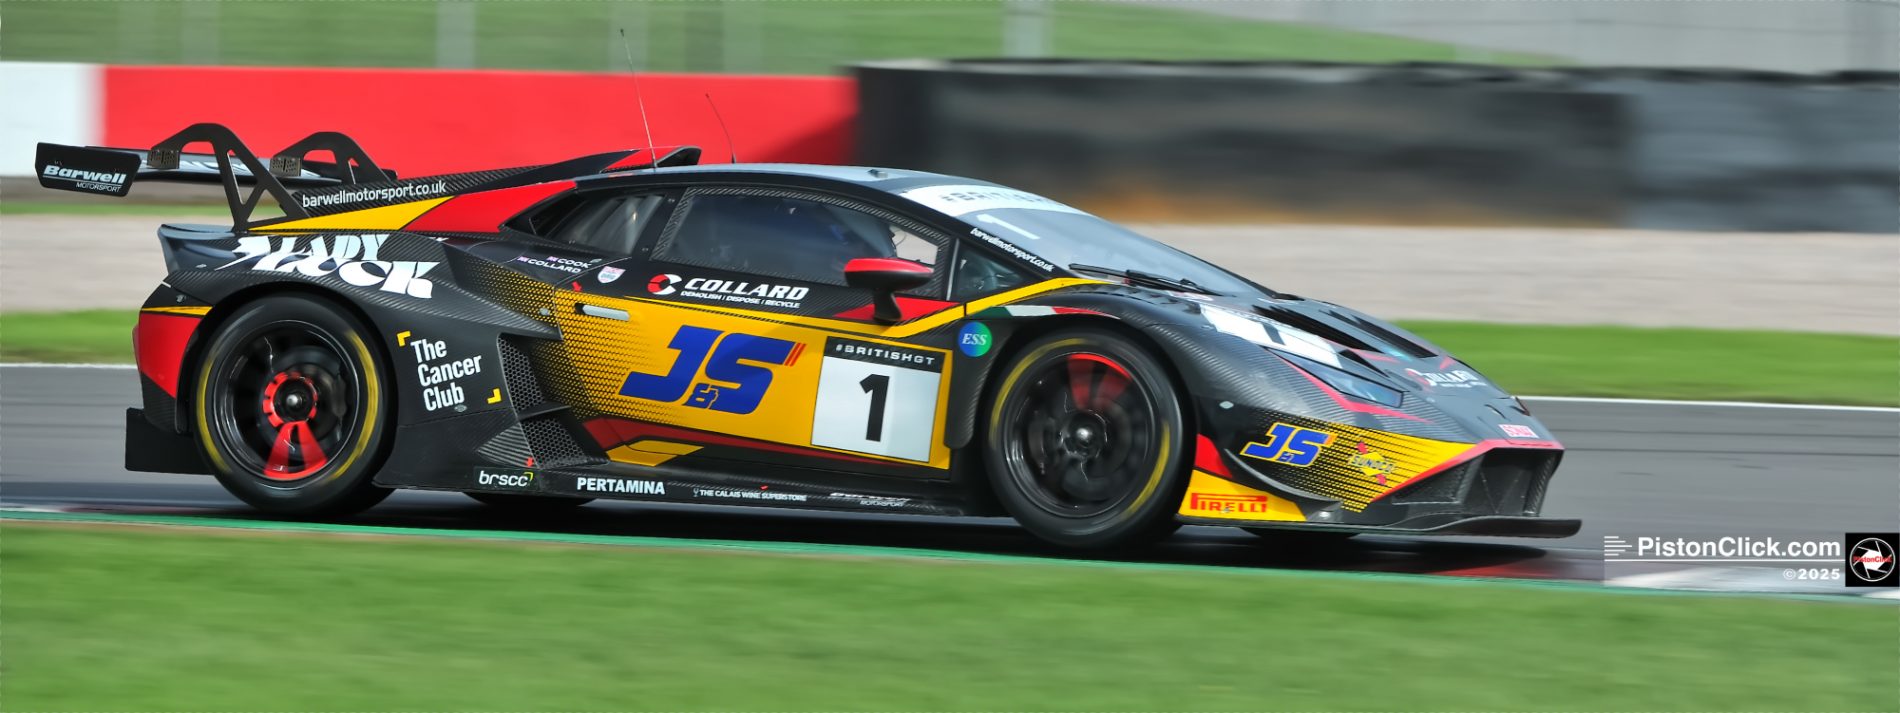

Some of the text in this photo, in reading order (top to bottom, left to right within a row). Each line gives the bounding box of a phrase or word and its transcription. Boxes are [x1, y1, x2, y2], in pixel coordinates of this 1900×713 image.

[43, 164, 126, 184] Barwell
[75, 181, 123, 193] MOTORSPORT
[302, 180, 446, 207] barwellmotorsport.co.uk
[970, 228, 1055, 272] barwellmotorsport.co.uk
[251, 247, 441, 299] LUCK
[527, 259, 582, 274] COLLARD
[557, 258, 593, 269] COOK
[680, 290, 801, 309] DEMOLISH DISPOSE RECYCLE
[684, 278, 809, 301] COLLARD
[961, 333, 987, 346] ESS
[410, 338, 447, 363] The
[835, 343, 936, 366] #BRITISHGT
[417, 355, 482, 387] Cancer
[423, 382, 465, 411] Club
[859, 373, 890, 442] 1
[1351, 454, 1395, 474] SUNOCO
[478, 470, 530, 487] brscc
[576, 477, 666, 495] PERTAMINA
[700, 489, 714, 498] THE
[715, 490, 741, 499] CALAIS
[742, 492, 760, 500] WINE
[1191, 493, 1268, 513] PIRELLI
